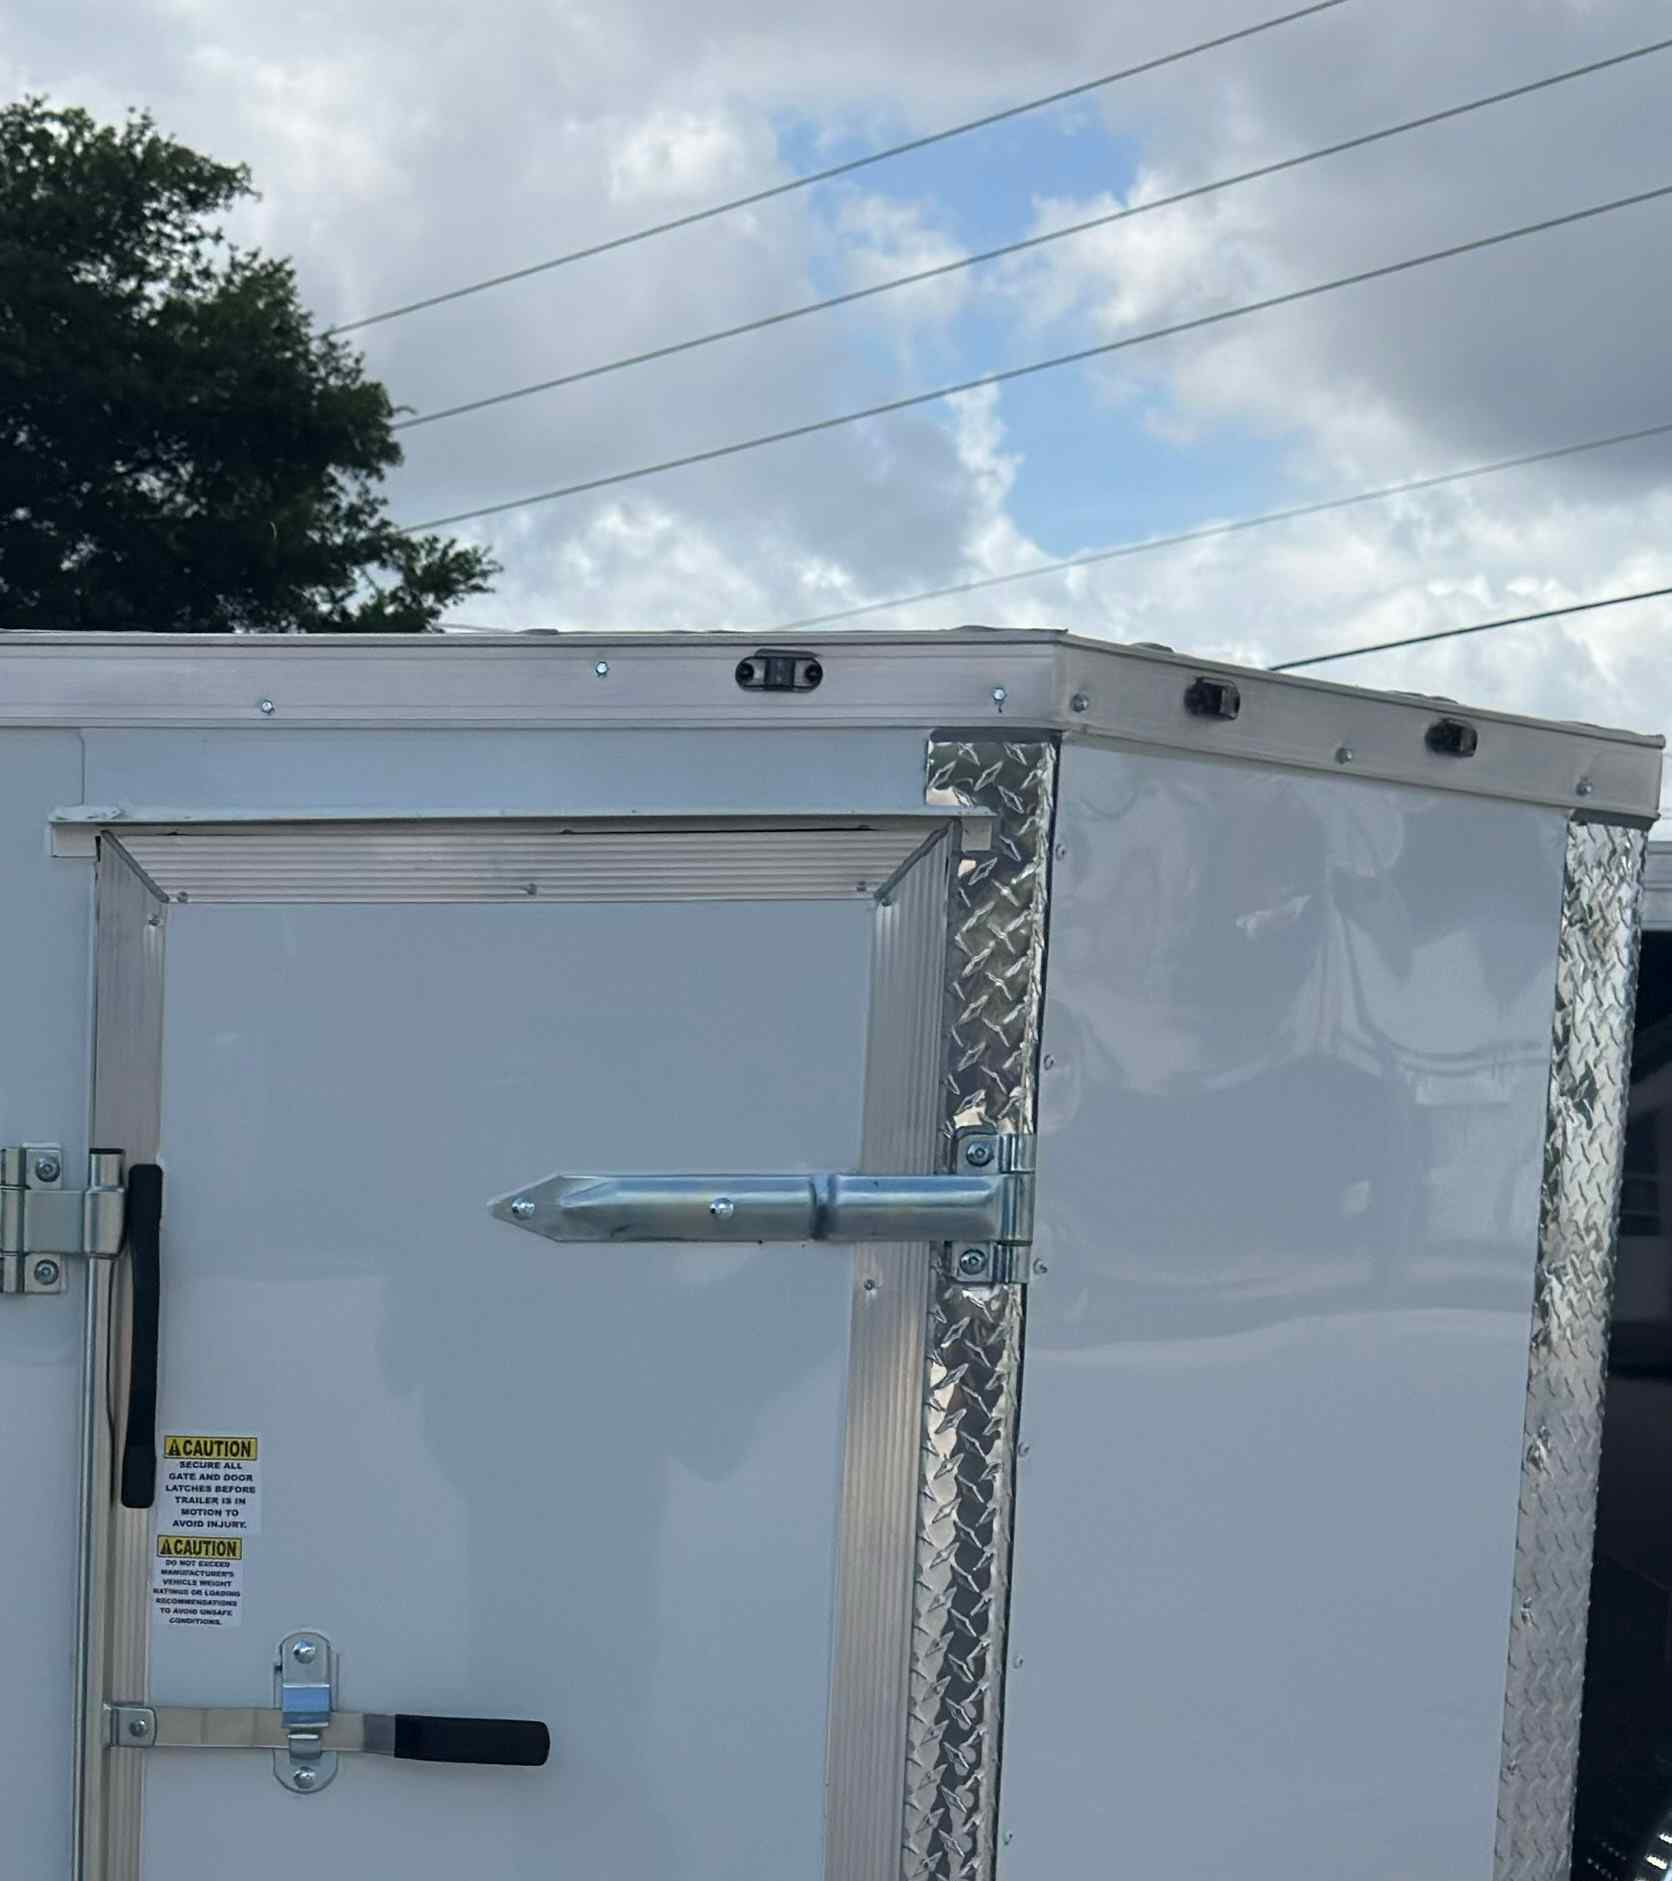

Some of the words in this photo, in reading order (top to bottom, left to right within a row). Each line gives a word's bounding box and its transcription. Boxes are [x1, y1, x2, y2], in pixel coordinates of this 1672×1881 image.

[183, 1439, 251, 1457] CAUTION
[179, 1461, 220, 1469] SECURE
[224, 1462, 243, 1470] ALL
[199, 1473, 221, 1481] AND
[165, 1485, 212, 1493] LATCHES
[215, 1485, 256, 1494] BEFORE
[175, 1496, 219, 1504] TRAILER
[181, 1508, 222, 1516] MOTION
[172, 1520, 203, 1528] AVOID
[174, 1539, 236, 1556] CAUTION
